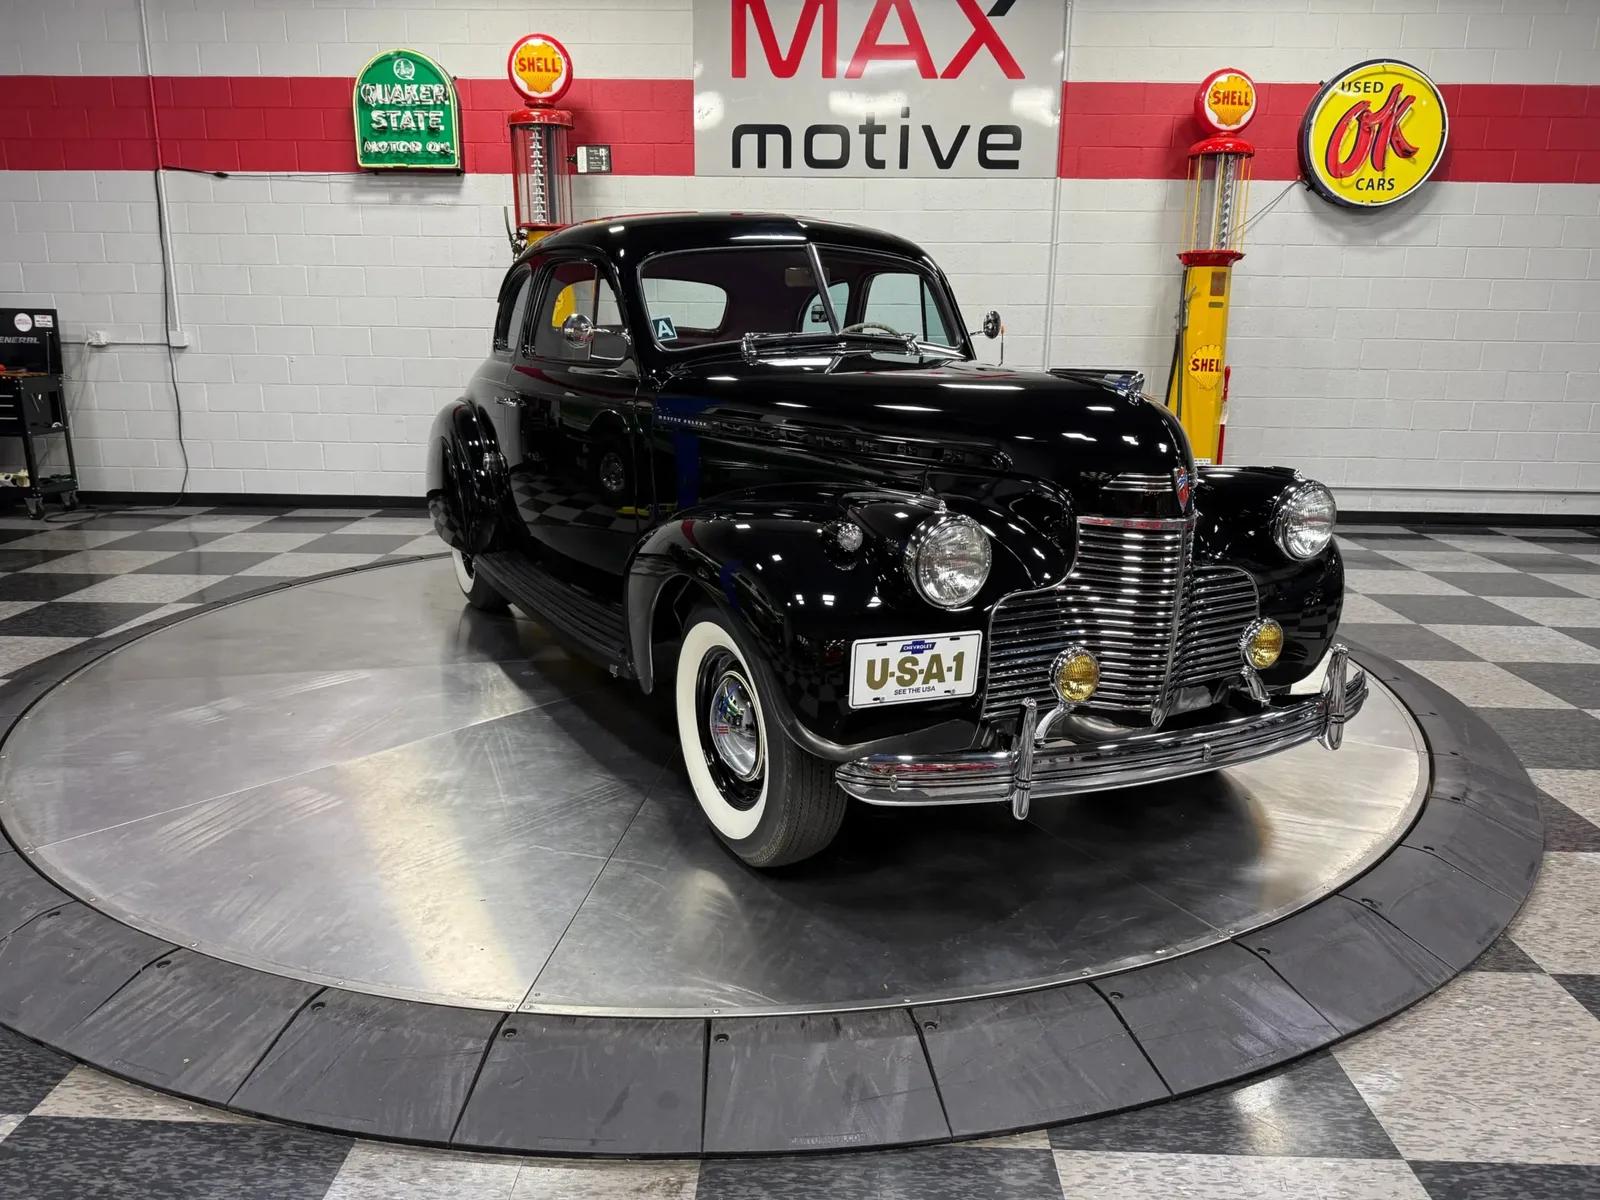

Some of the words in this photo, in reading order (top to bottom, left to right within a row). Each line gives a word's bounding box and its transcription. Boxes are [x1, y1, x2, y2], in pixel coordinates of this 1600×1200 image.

[731, 0, 1026, 80] MAX
[518, 56, 560, 74] SHELL
[360, 83, 450, 107] QUAKER
[1341, 81, 1384, 94] USED
[1212, 90, 1250, 107] SHELL
[370, 110, 445, 131] STATE
[731, 106, 1022, 170] motive
[1325, 83, 1420, 179] OK
[363, 140, 423, 154] MOTOR
[1355, 177, 1395, 192] CARS
[657, 320, 674, 338] A
[902, 643, 933, 651] CHEVROLET
[866, 651, 965, 690] U-S-A-1
[894, 688, 907, 696] SEE
[908, 686, 921, 694] THE
[922, 685, 936, 693] USA
